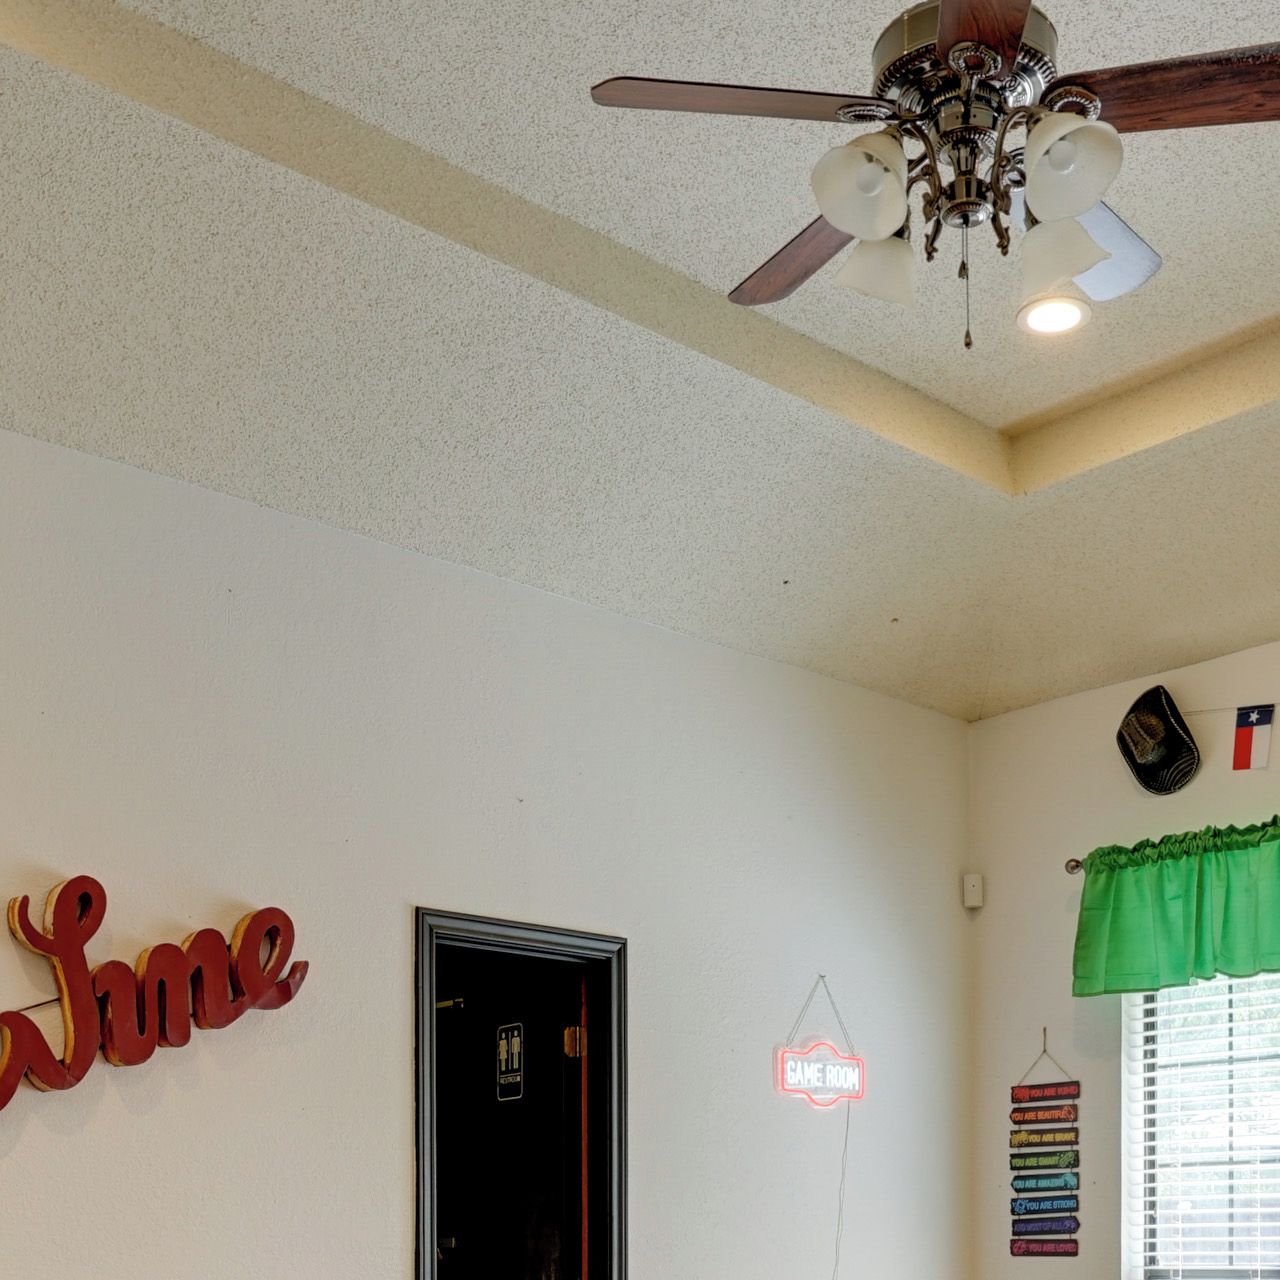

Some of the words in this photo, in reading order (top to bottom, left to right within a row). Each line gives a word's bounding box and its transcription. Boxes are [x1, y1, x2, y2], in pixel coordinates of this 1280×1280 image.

[786, 1060, 824, 1087] GAME
[825, 1064, 860, 1091] ROOM
[1031, 1089, 1043, 1097] YOU
[1045, 1088, 1056, 1096] ARE
[1012, 1113, 1024, 1121] YOU
[1030, 1135, 1041, 1143] YOU
[1043, 1134, 1054, 1142] ARE
[1012, 1159, 1024, 1167] YOU
[1026, 1158, 1038, 1166] ARE
[1013, 1181, 1024, 1189] YOU
[1026, 1180, 1037, 1188] ARE
[1027, 1202, 1039, 1210] YOU
[1040, 1201, 1052, 1209] ARE
[1053, 1200, 1077, 1209] STRONG
